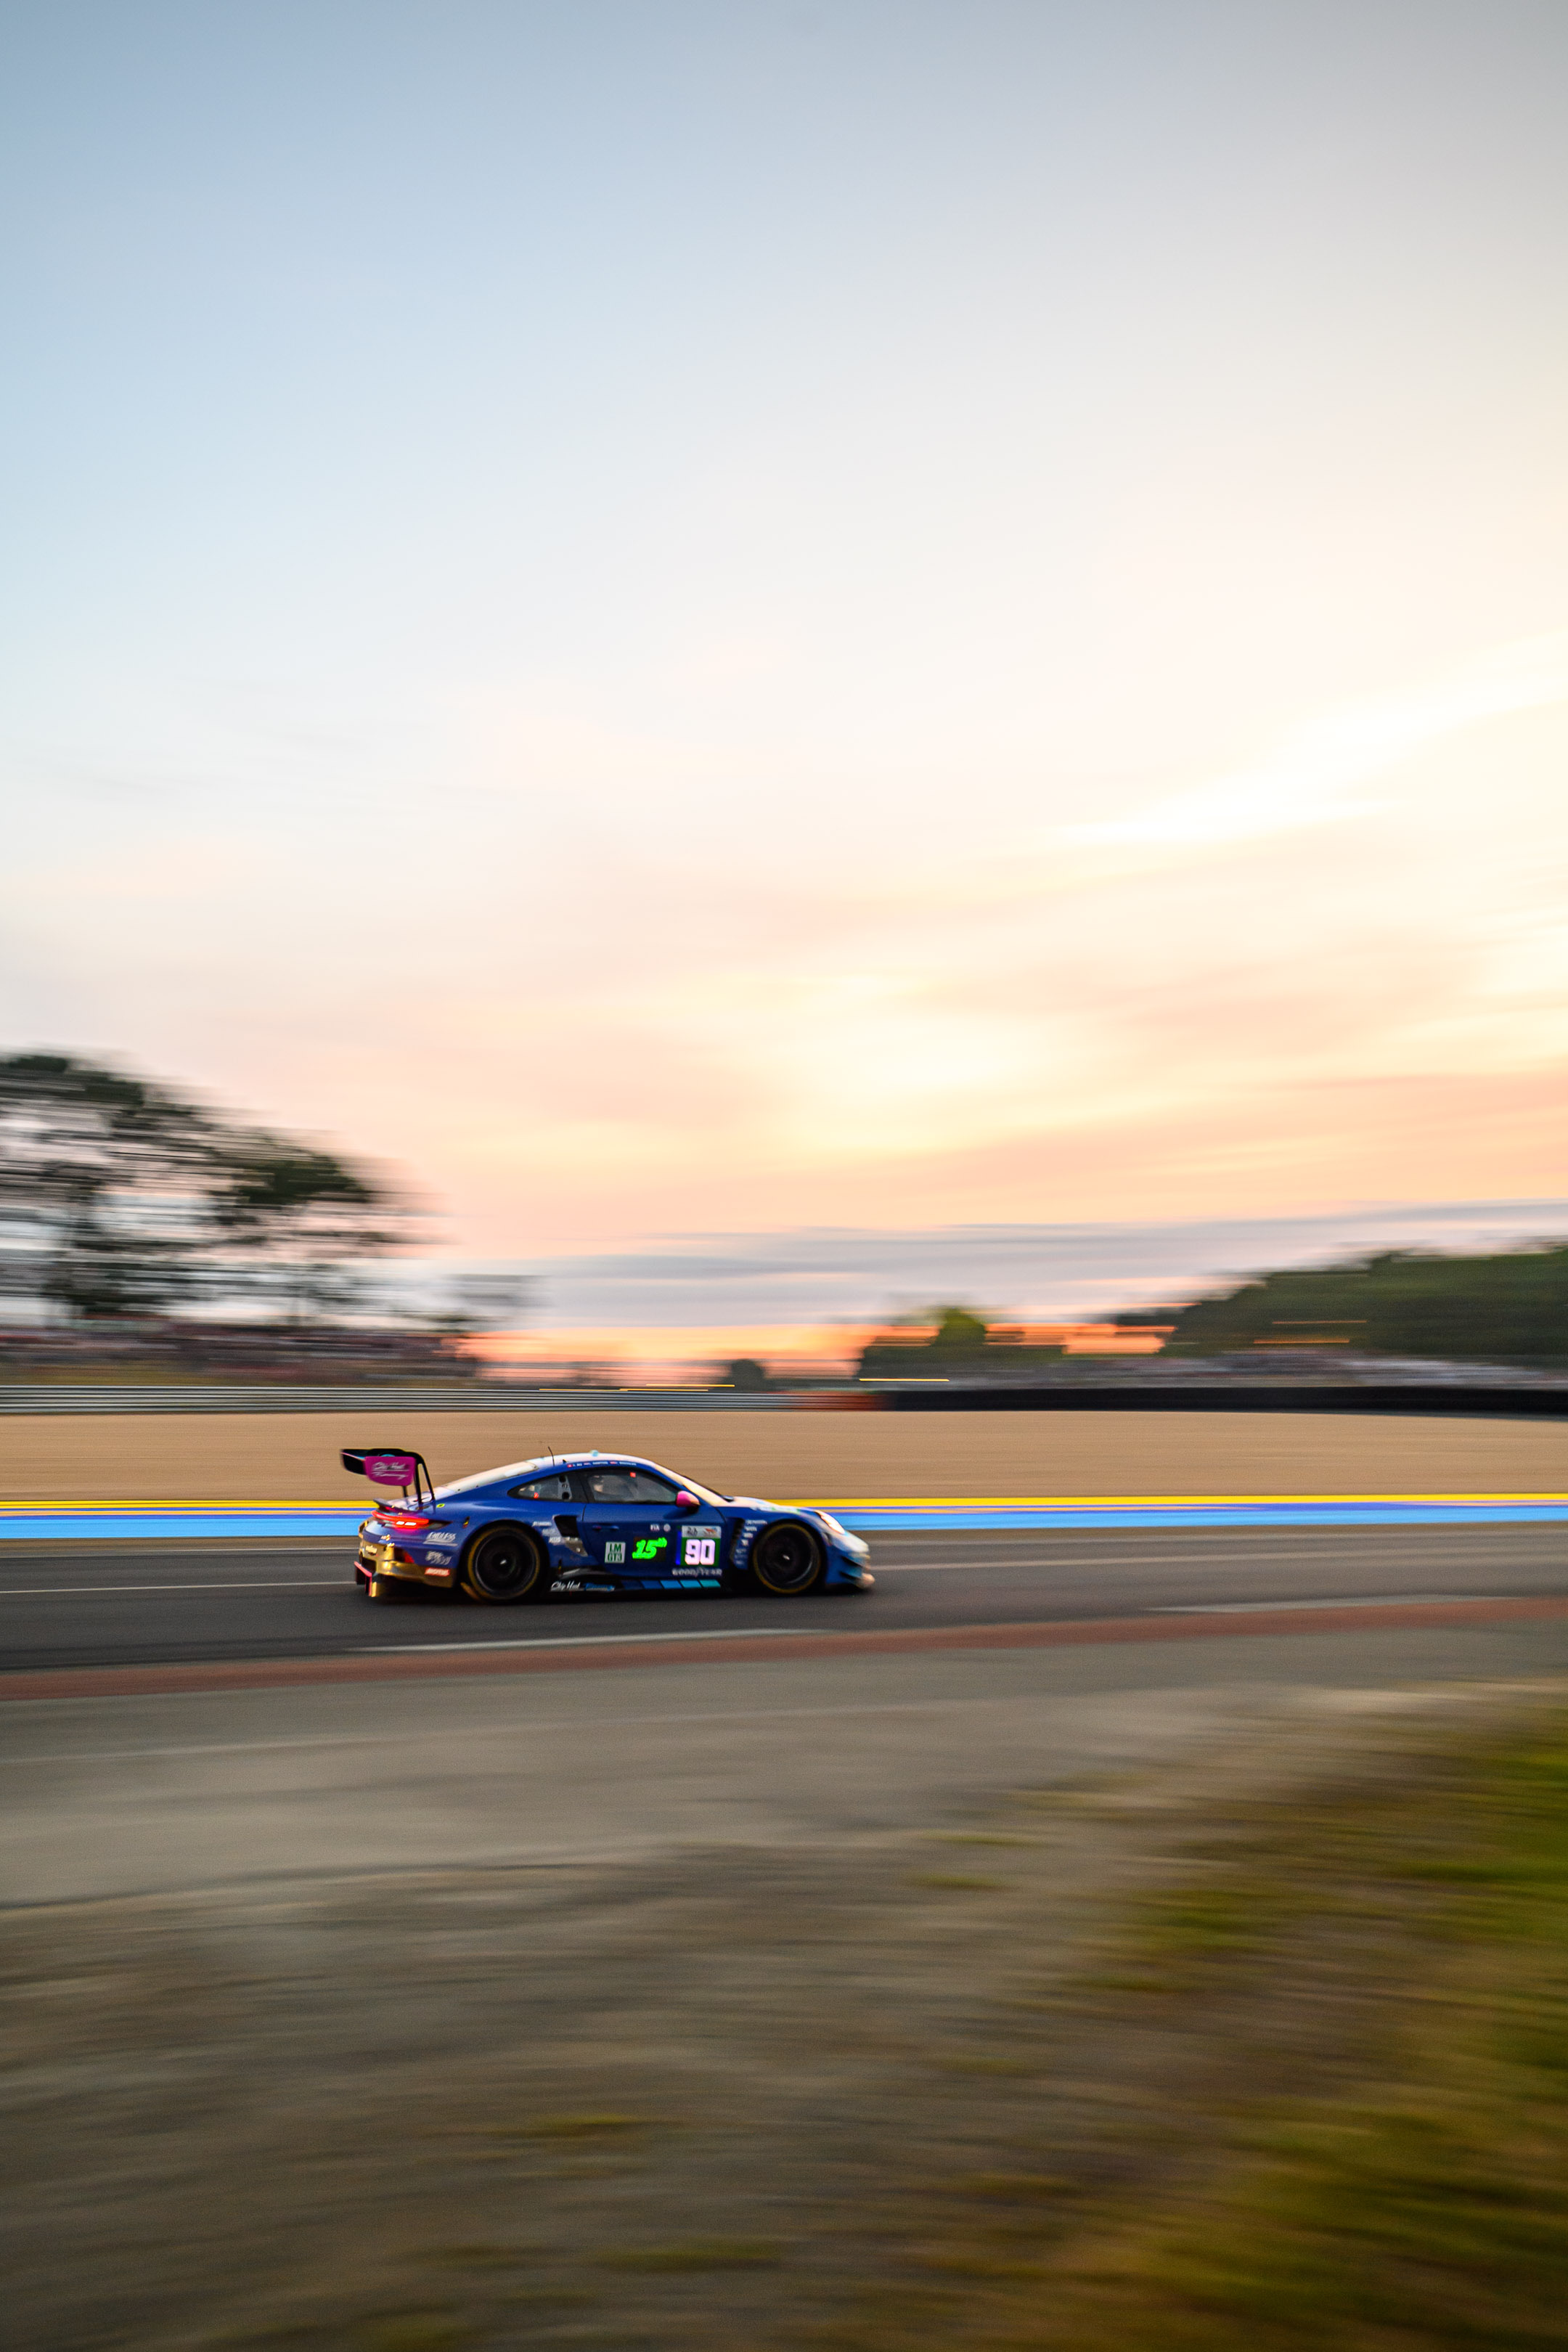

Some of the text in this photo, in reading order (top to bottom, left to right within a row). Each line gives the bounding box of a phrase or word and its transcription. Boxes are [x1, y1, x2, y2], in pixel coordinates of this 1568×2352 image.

[609, 1543, 621, 1552] LM
[685, 1539, 715, 1565] 90
[607, 1552, 622, 1561] GT3
